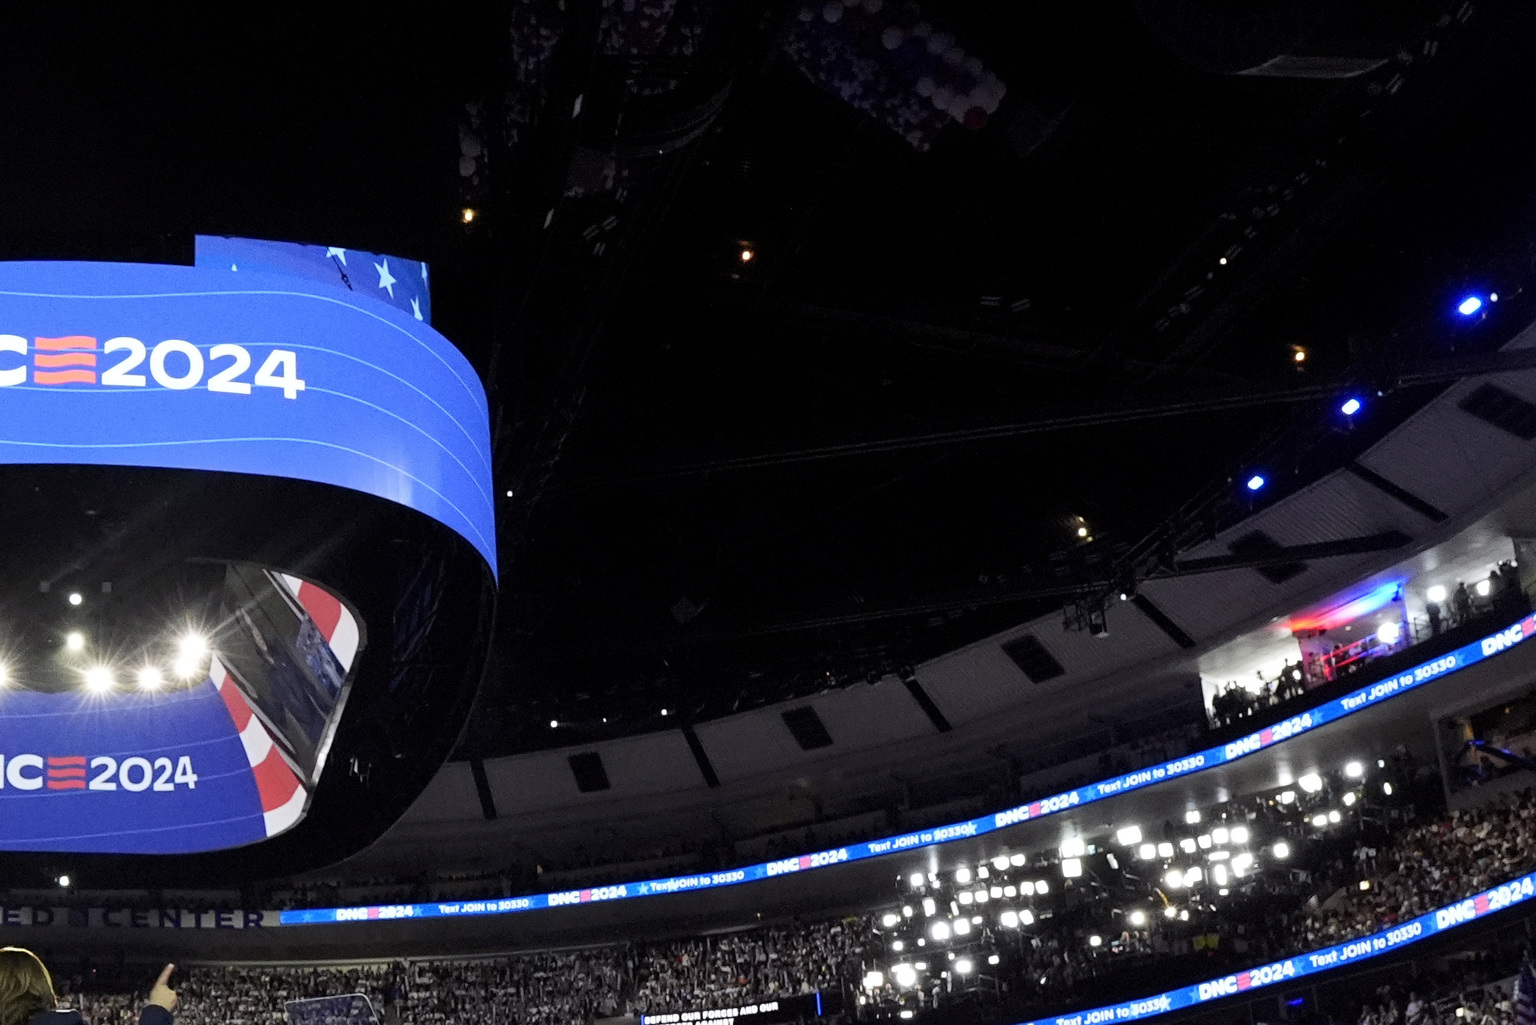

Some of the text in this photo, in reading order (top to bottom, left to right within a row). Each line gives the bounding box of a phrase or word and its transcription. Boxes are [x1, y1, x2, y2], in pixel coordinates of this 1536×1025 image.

[102, 336, 306, 400] 2024
[1481, 624, 1523, 657] DNC
[1341, 656, 1456, 710] Text JOIN to 30330
[1225, 713, 1312, 760] DNC 2024
[89, 754, 198, 793] 2024
[1098, 755, 1205, 795] Text JOIN to 30330
[995, 791, 1079, 827] DNC 2024
[767, 848, 848, 875] DNC 2024
[336, 905, 413, 920] DNC 2024
[548, 885, 627, 906] DNC 2024
[1435, 877, 1534, 929] DNC 2024
[103, 907, 264, 929] CENTER
[1309, 921, 1423, 969] Text JOIN to 30330
[1198, 959, 1295, 1001] DNC 2024
[1116, 1006, 1129, 1019] to
